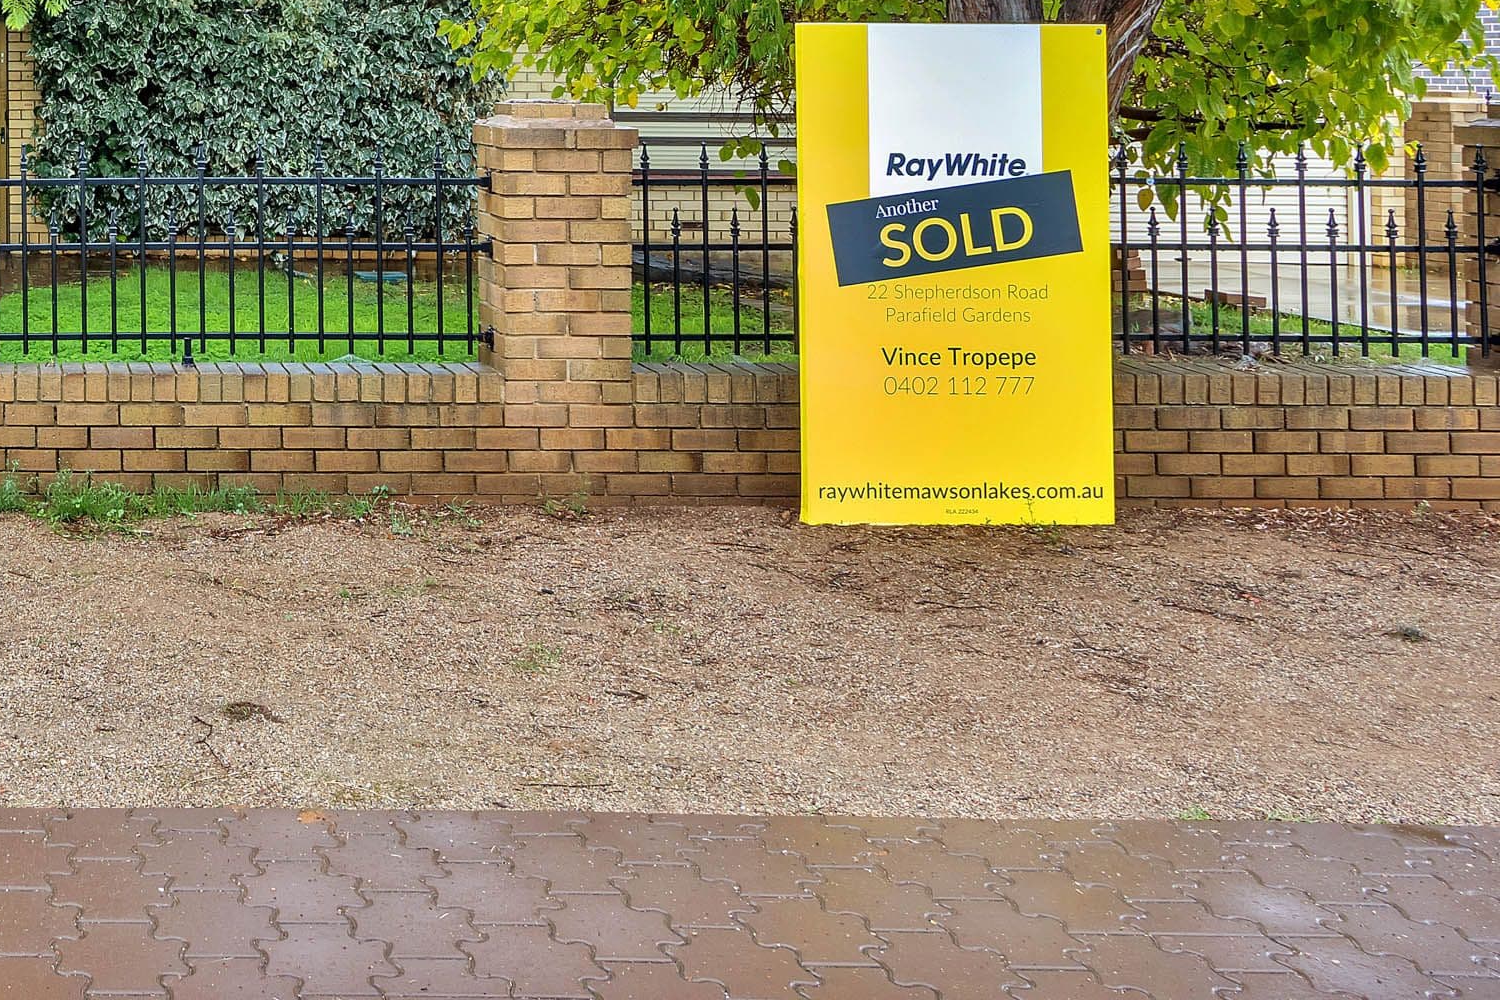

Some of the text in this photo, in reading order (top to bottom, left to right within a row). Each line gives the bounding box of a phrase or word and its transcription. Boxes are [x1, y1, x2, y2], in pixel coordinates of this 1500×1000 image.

[875, 198, 939, 219] Another
[879, 206, 1034, 268] SOLD
[867, 284, 1049, 302] 22 Shepherdson Road
[886, 307, 1031, 323] Parafield Gardens
[881, 347, 1037, 370] Vince Tropepe
[884, 376, 1035, 395] 0402 112 777
[818, 482, 1104, 502] raywhitemawsonlakes.com.au
